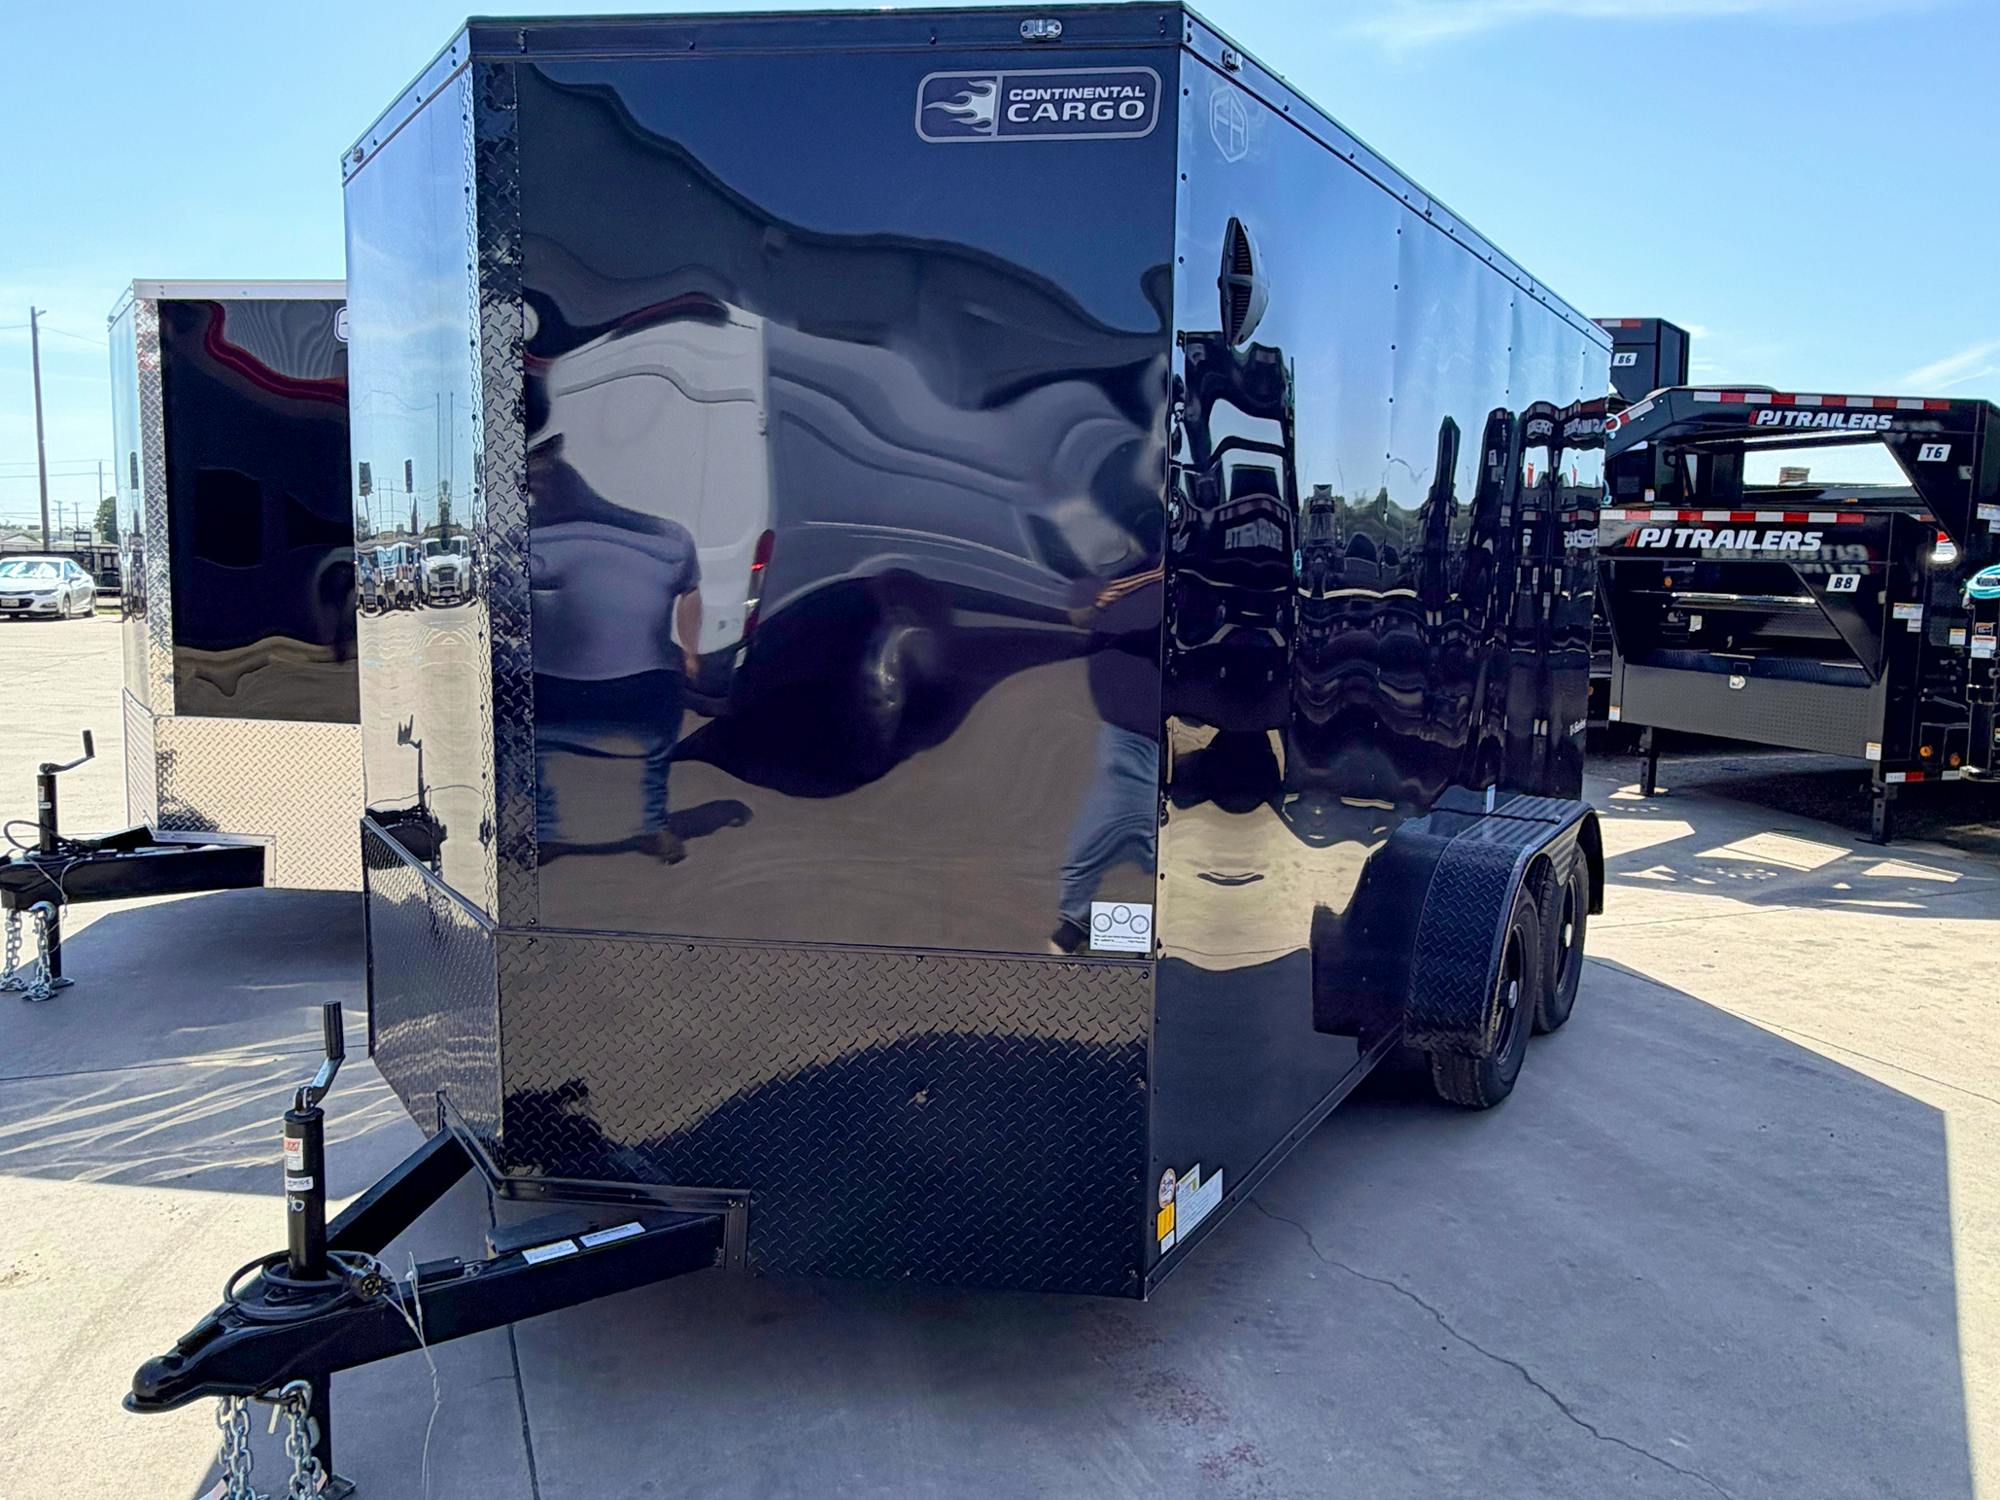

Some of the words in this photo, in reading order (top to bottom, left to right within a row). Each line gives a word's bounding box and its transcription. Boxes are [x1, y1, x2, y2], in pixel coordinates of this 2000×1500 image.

[1009, 86, 1145, 101] CONTINENTAL
[1007, 100, 1145, 122] CARGO
[1756, 410, 1784, 426] PJ
[1784, 411, 1893, 430] TRAILERS
[1925, 446, 1943, 459] T6
[1637, 528, 1669, 548] PJ
[1674, 529, 1823, 551] TRAILERS
[1834, 576, 1853, 589] B8
